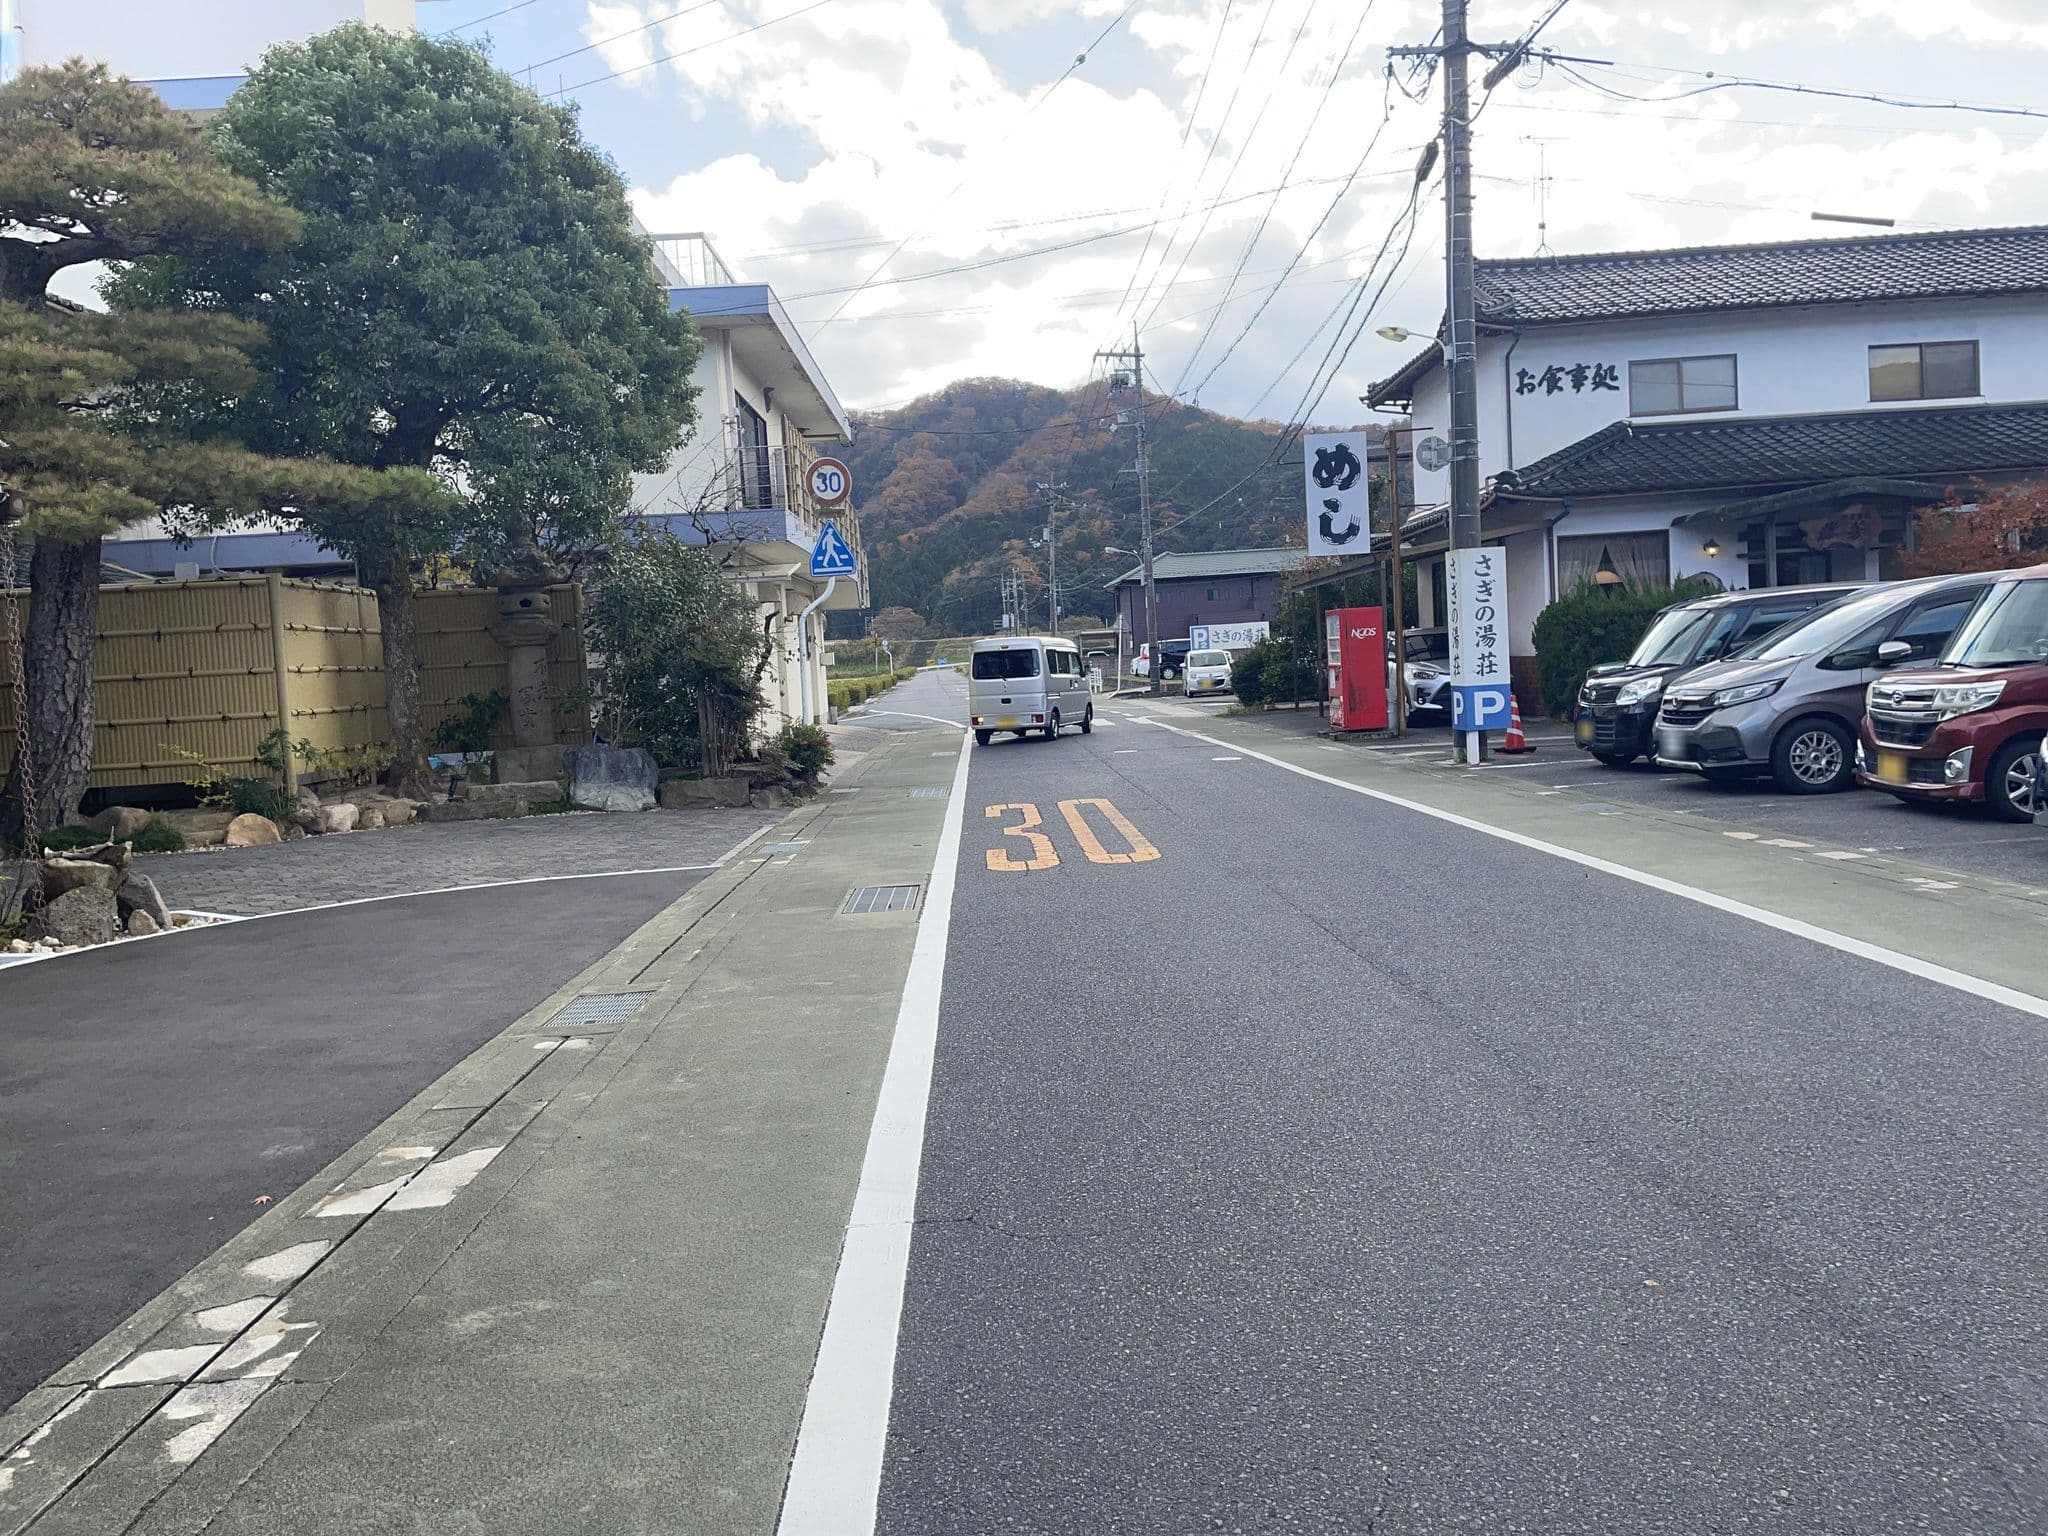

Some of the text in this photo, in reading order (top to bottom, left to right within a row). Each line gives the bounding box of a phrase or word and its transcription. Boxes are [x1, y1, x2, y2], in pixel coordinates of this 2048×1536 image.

[1515, 362, 1620, 396] お食事処
[816, 472, 841, 493] 30
[1311, 442, 1362, 546] めし
[1474, 554, 1498, 677] さぎの湯荘
[1453, 691, 1464, 725] P
[1474, 690, 1505, 726] P
[984, 798, 1163, 872] 30
